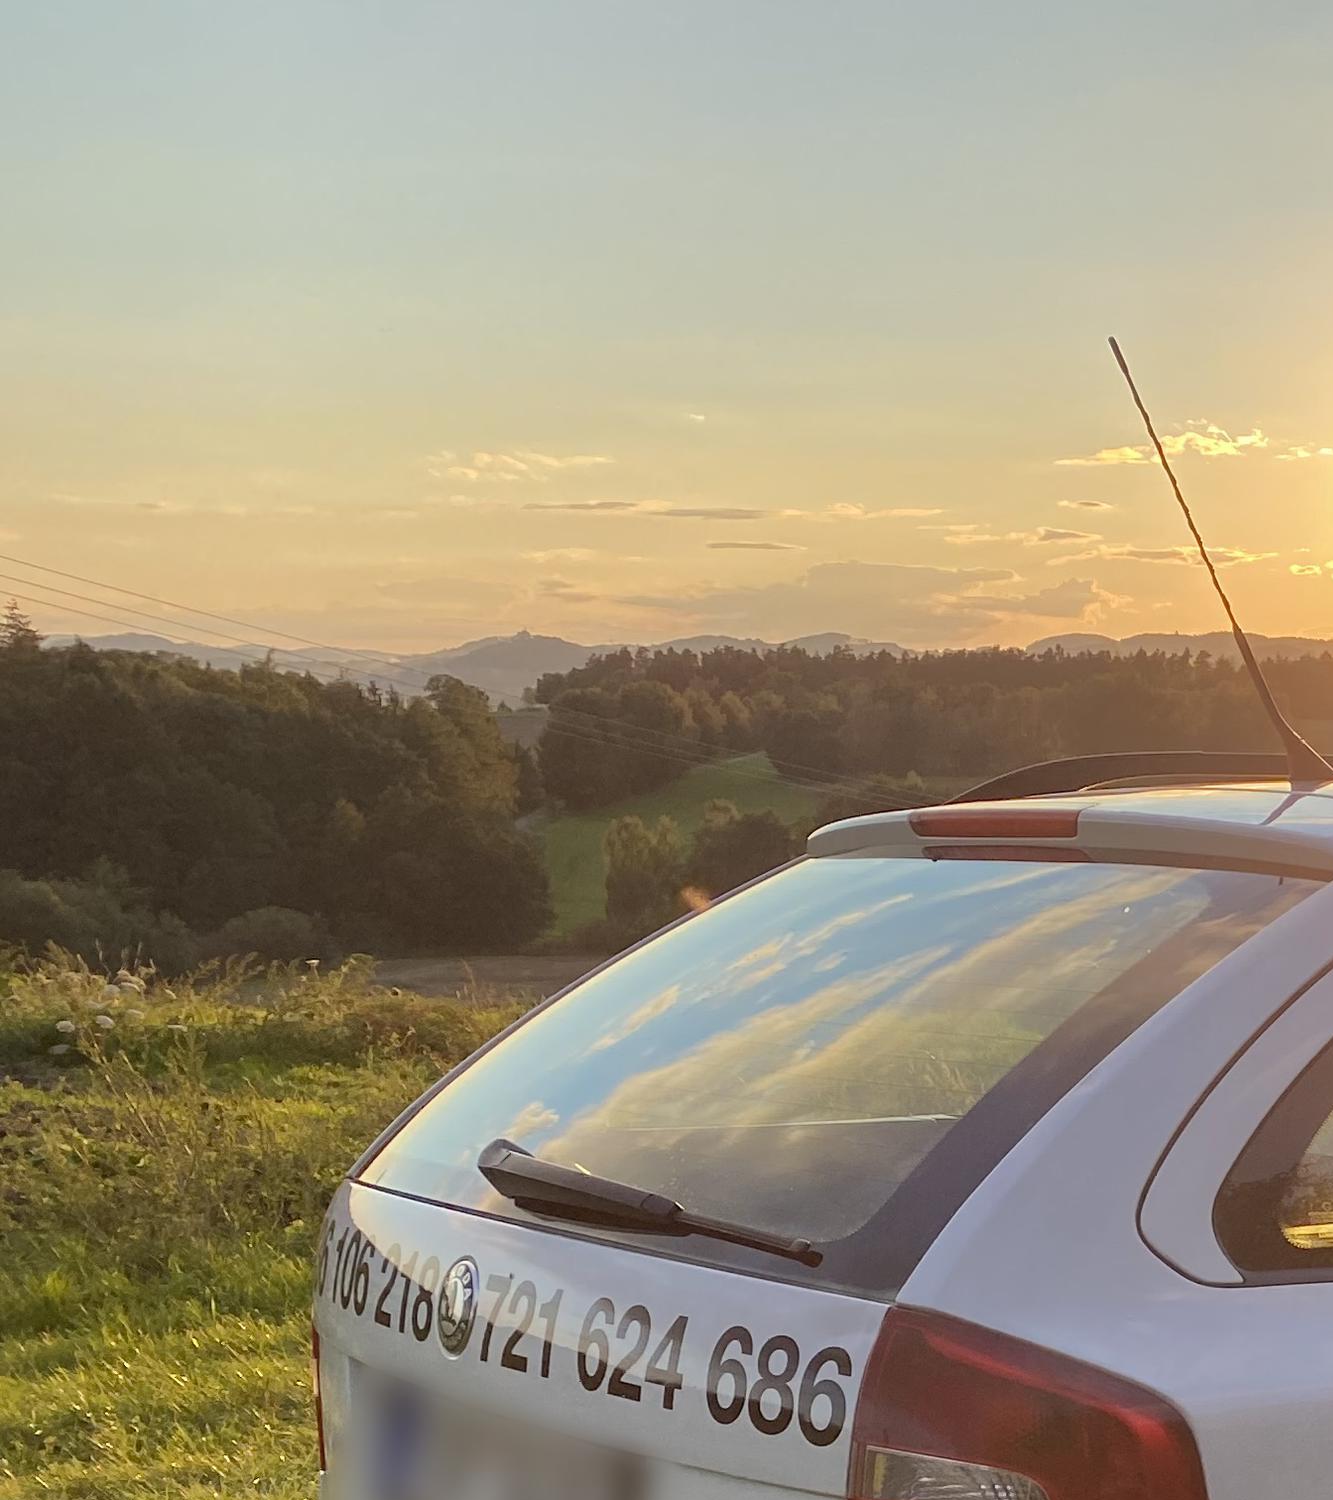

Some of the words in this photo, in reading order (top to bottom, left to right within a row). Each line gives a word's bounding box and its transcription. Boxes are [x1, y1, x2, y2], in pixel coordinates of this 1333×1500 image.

[333, 1227, 376, 1317] 106
[374, 1243, 441, 1342] 218
[480, 1272, 564, 1378] 721
[577, 1296, 689, 1411] 624
[706, 1325, 852, 1447] 686
